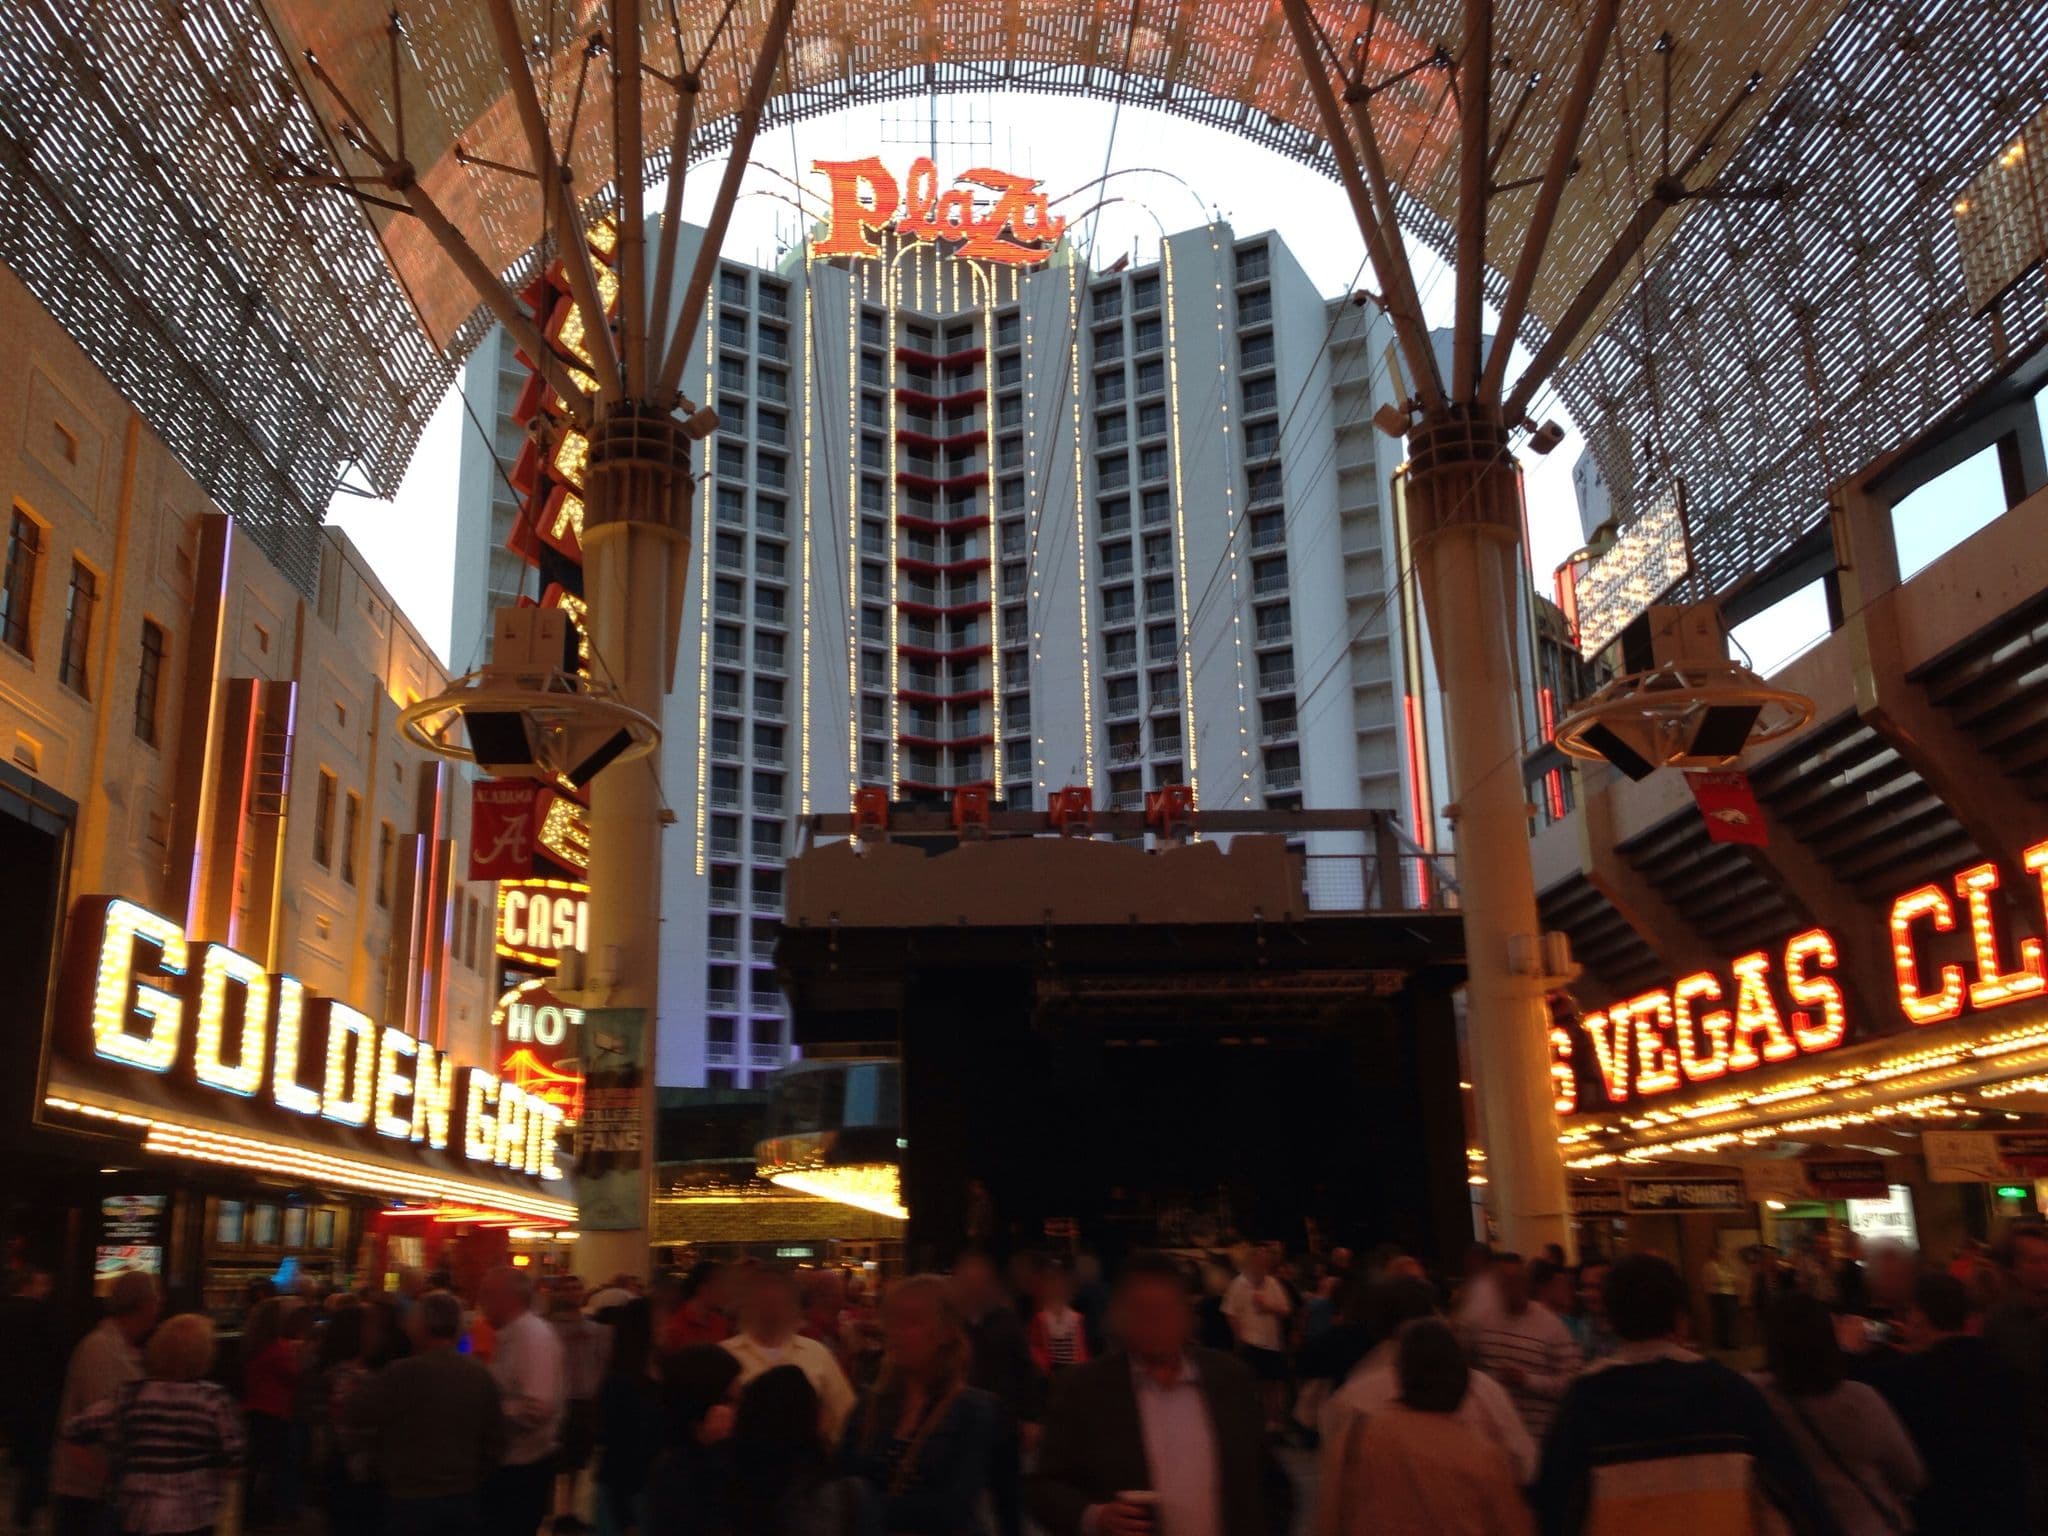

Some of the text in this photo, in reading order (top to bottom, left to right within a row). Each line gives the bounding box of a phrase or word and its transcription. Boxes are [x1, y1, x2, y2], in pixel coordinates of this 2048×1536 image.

[808, 156, 1066, 268] Plaza
[93, 897, 565, 1181] GOLDEN GATE
[1583, 928, 1847, 1103] VEGAS
